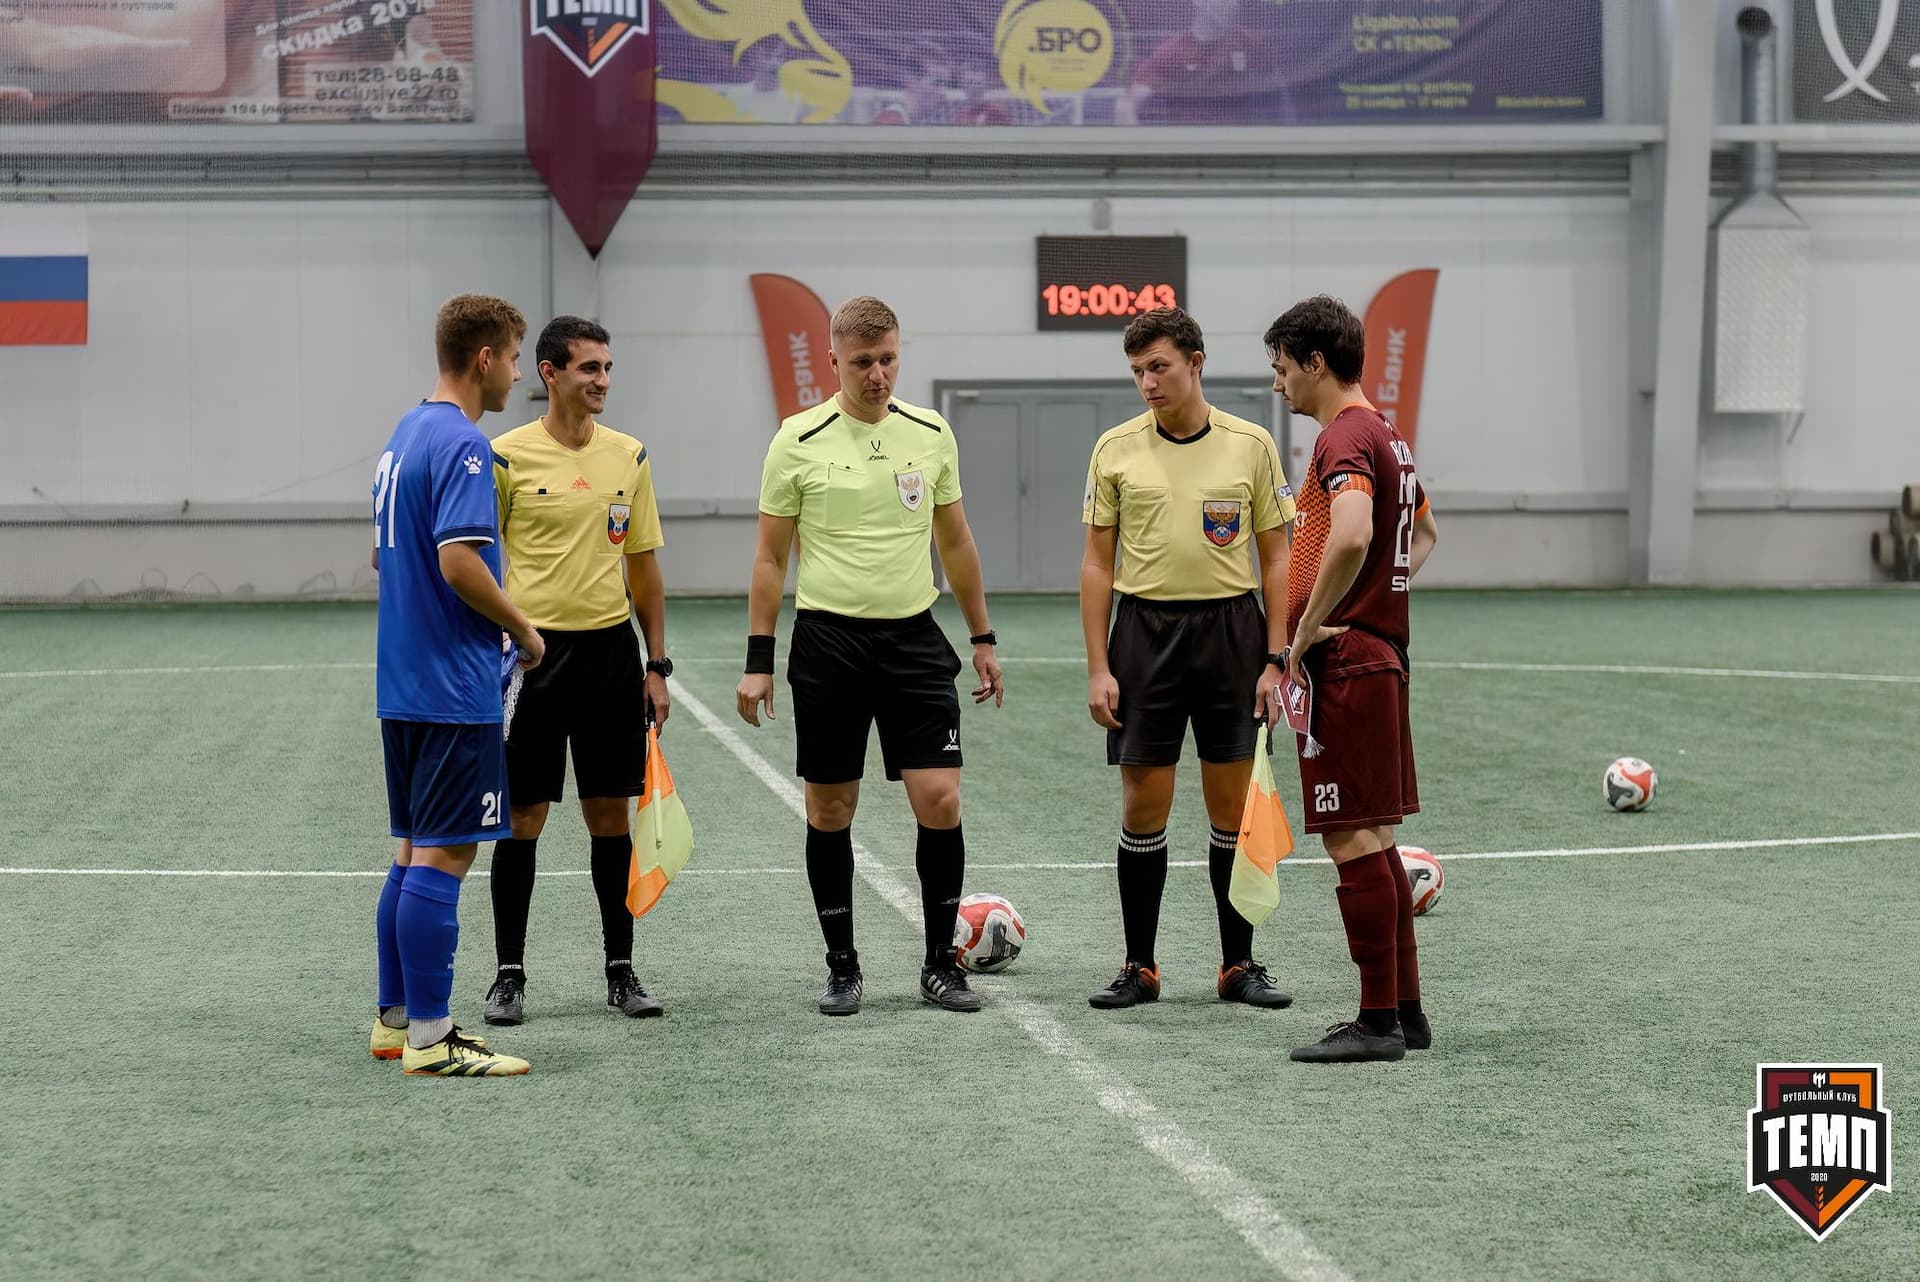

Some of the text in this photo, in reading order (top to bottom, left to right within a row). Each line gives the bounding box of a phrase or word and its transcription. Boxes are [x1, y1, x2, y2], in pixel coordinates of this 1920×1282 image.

[262, 16, 364, 60] скидка
[1043, 284, 1177, 316] 19:00:43
[1377, 328, 1407, 404] Банк
[481, 790, 502, 826] 21
[1314, 783, 1340, 813] 23
